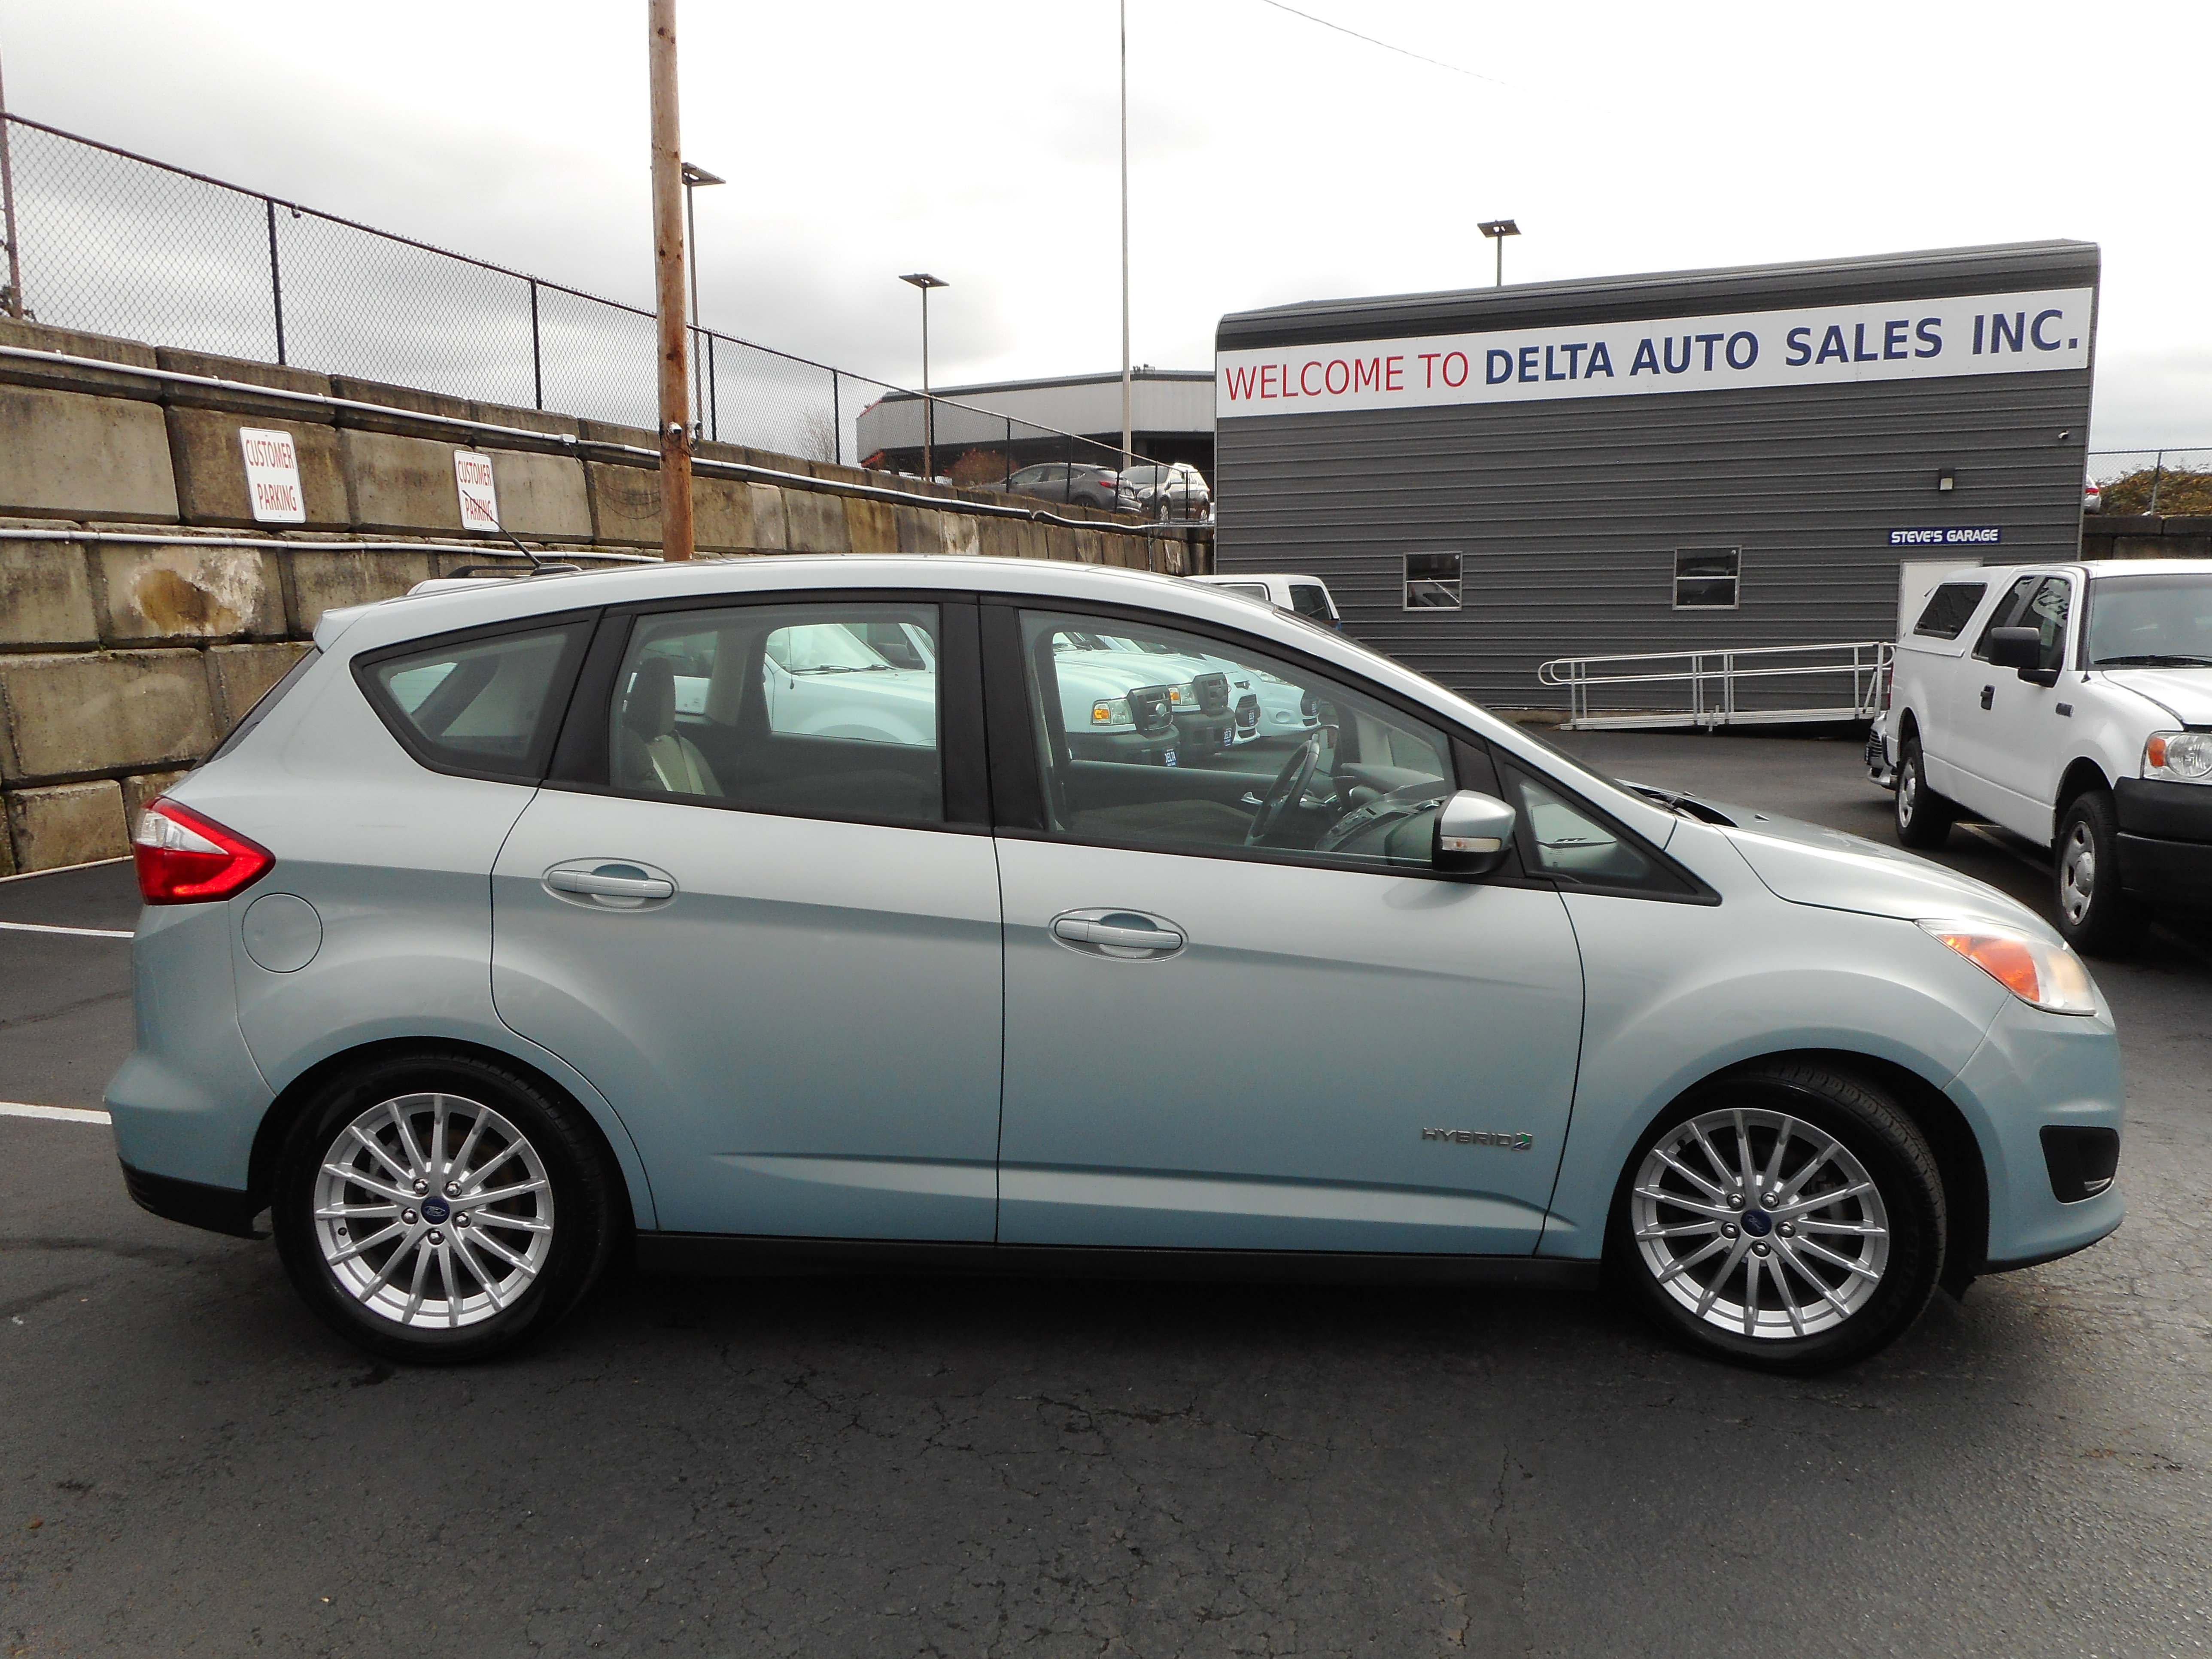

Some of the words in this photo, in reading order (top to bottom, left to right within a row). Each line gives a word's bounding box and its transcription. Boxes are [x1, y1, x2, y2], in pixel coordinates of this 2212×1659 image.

[1225, 355, 1404, 400] WELCOME
[1418, 351, 1469, 388] TO
[1486, 341, 1614, 384] DELTA
[1630, 331, 1759, 376] AUTO
[1785, 317, 1942, 366] SALES
[1972, 309, 2078, 355] INC.
[246, 439, 295, 469] CUSTOMER
[458, 460, 492, 486] CUSTOMER
[257, 483, 297, 511] PARKING
[465, 497, 493, 522] PARKING
[1891, 531, 1942, 543] STEVE'S
[1947, 529, 1999, 542] GARAGE
[1422, 1127, 1512, 1146] HYBRID
